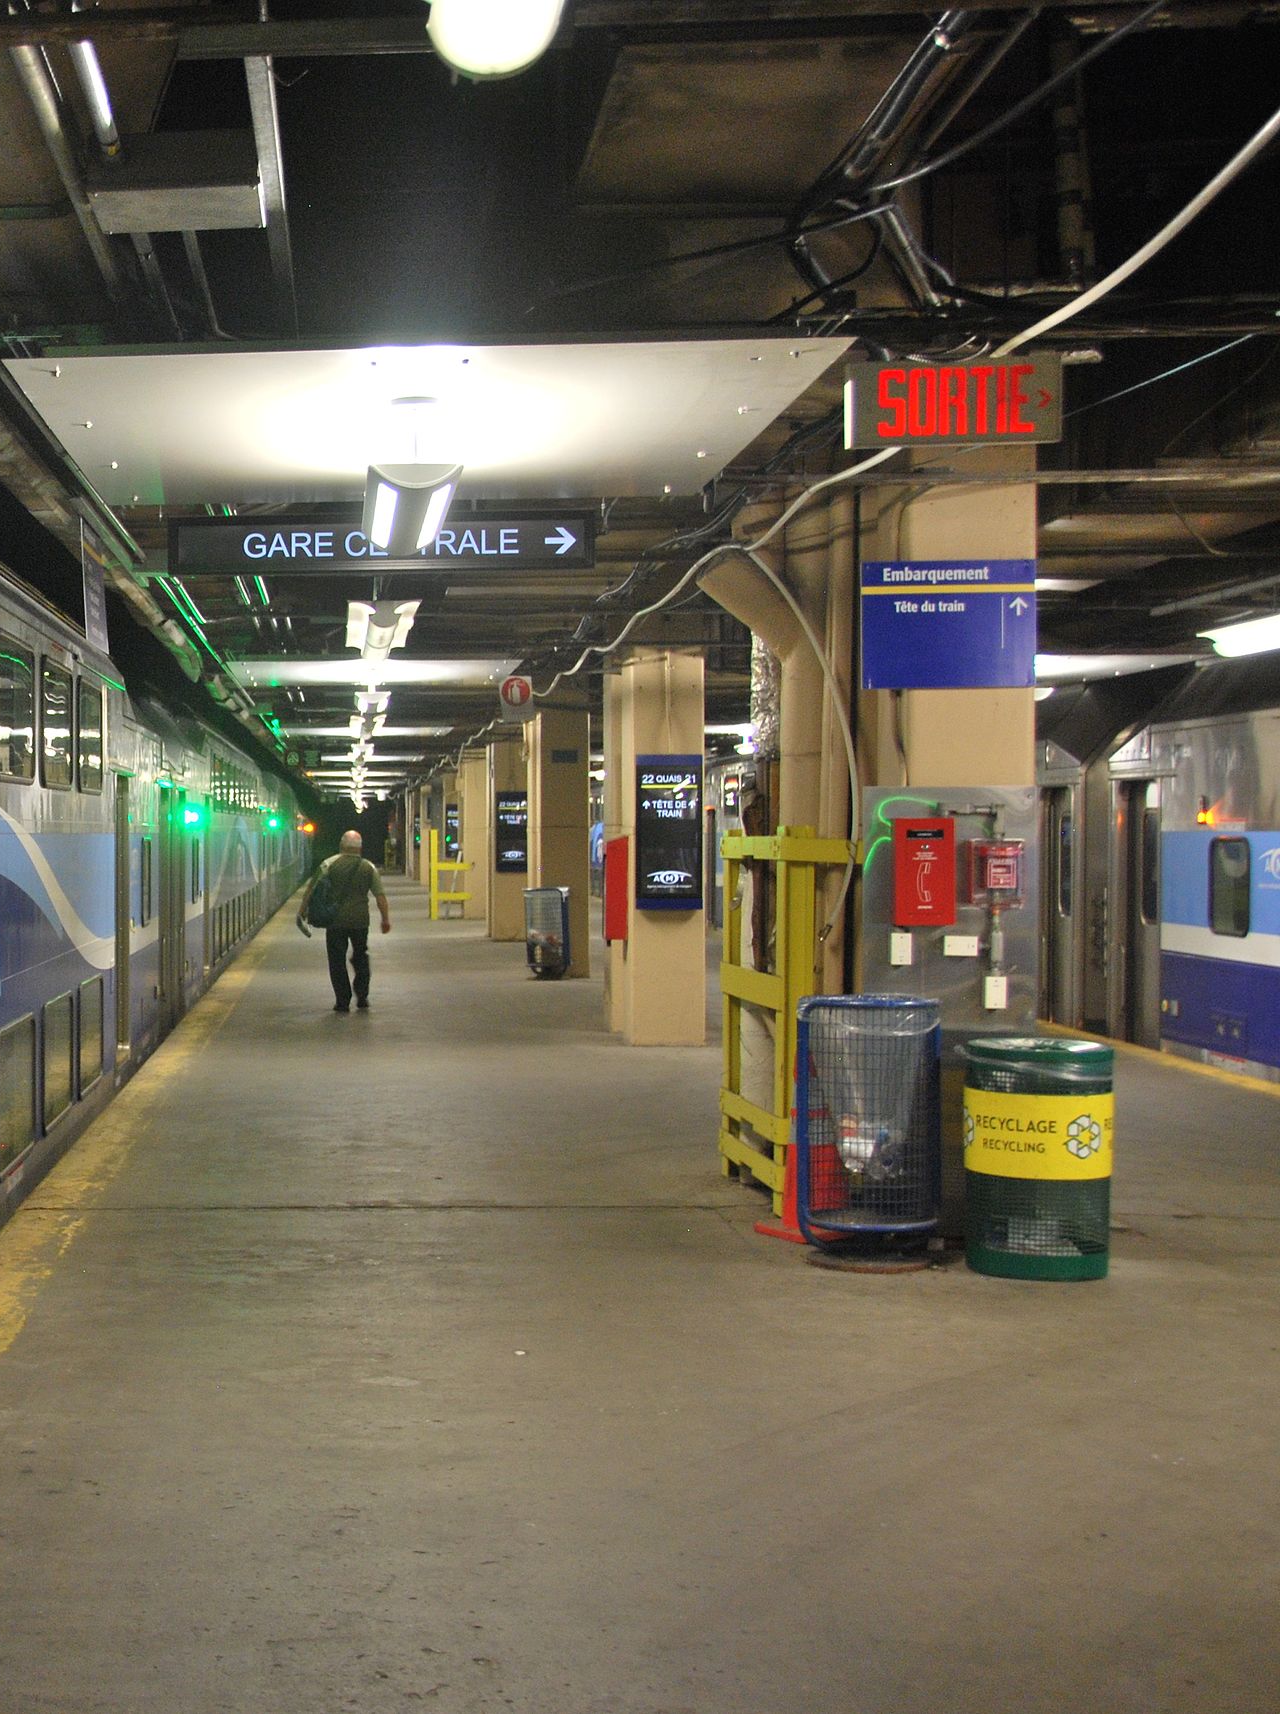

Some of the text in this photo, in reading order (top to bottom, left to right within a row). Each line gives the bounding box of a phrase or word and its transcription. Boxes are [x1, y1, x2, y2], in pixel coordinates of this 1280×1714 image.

[877, 364, 1045, 438] SORTIE
[243, 528, 520, 558] GARE CRALE
[883, 566, 990, 585] Embarquement
[894, 600, 965, 613] Tête du train
[641, 774, 655, 784] 22
[655, 774, 683, 784] QUAIS
[652, 799, 688, 809] TÊTE DE
[657, 809, 683, 818] TRAIN
[975, 1114, 1057, 1134] RECYCLAGE
[982, 1137, 1046, 1154] RECYCLING
